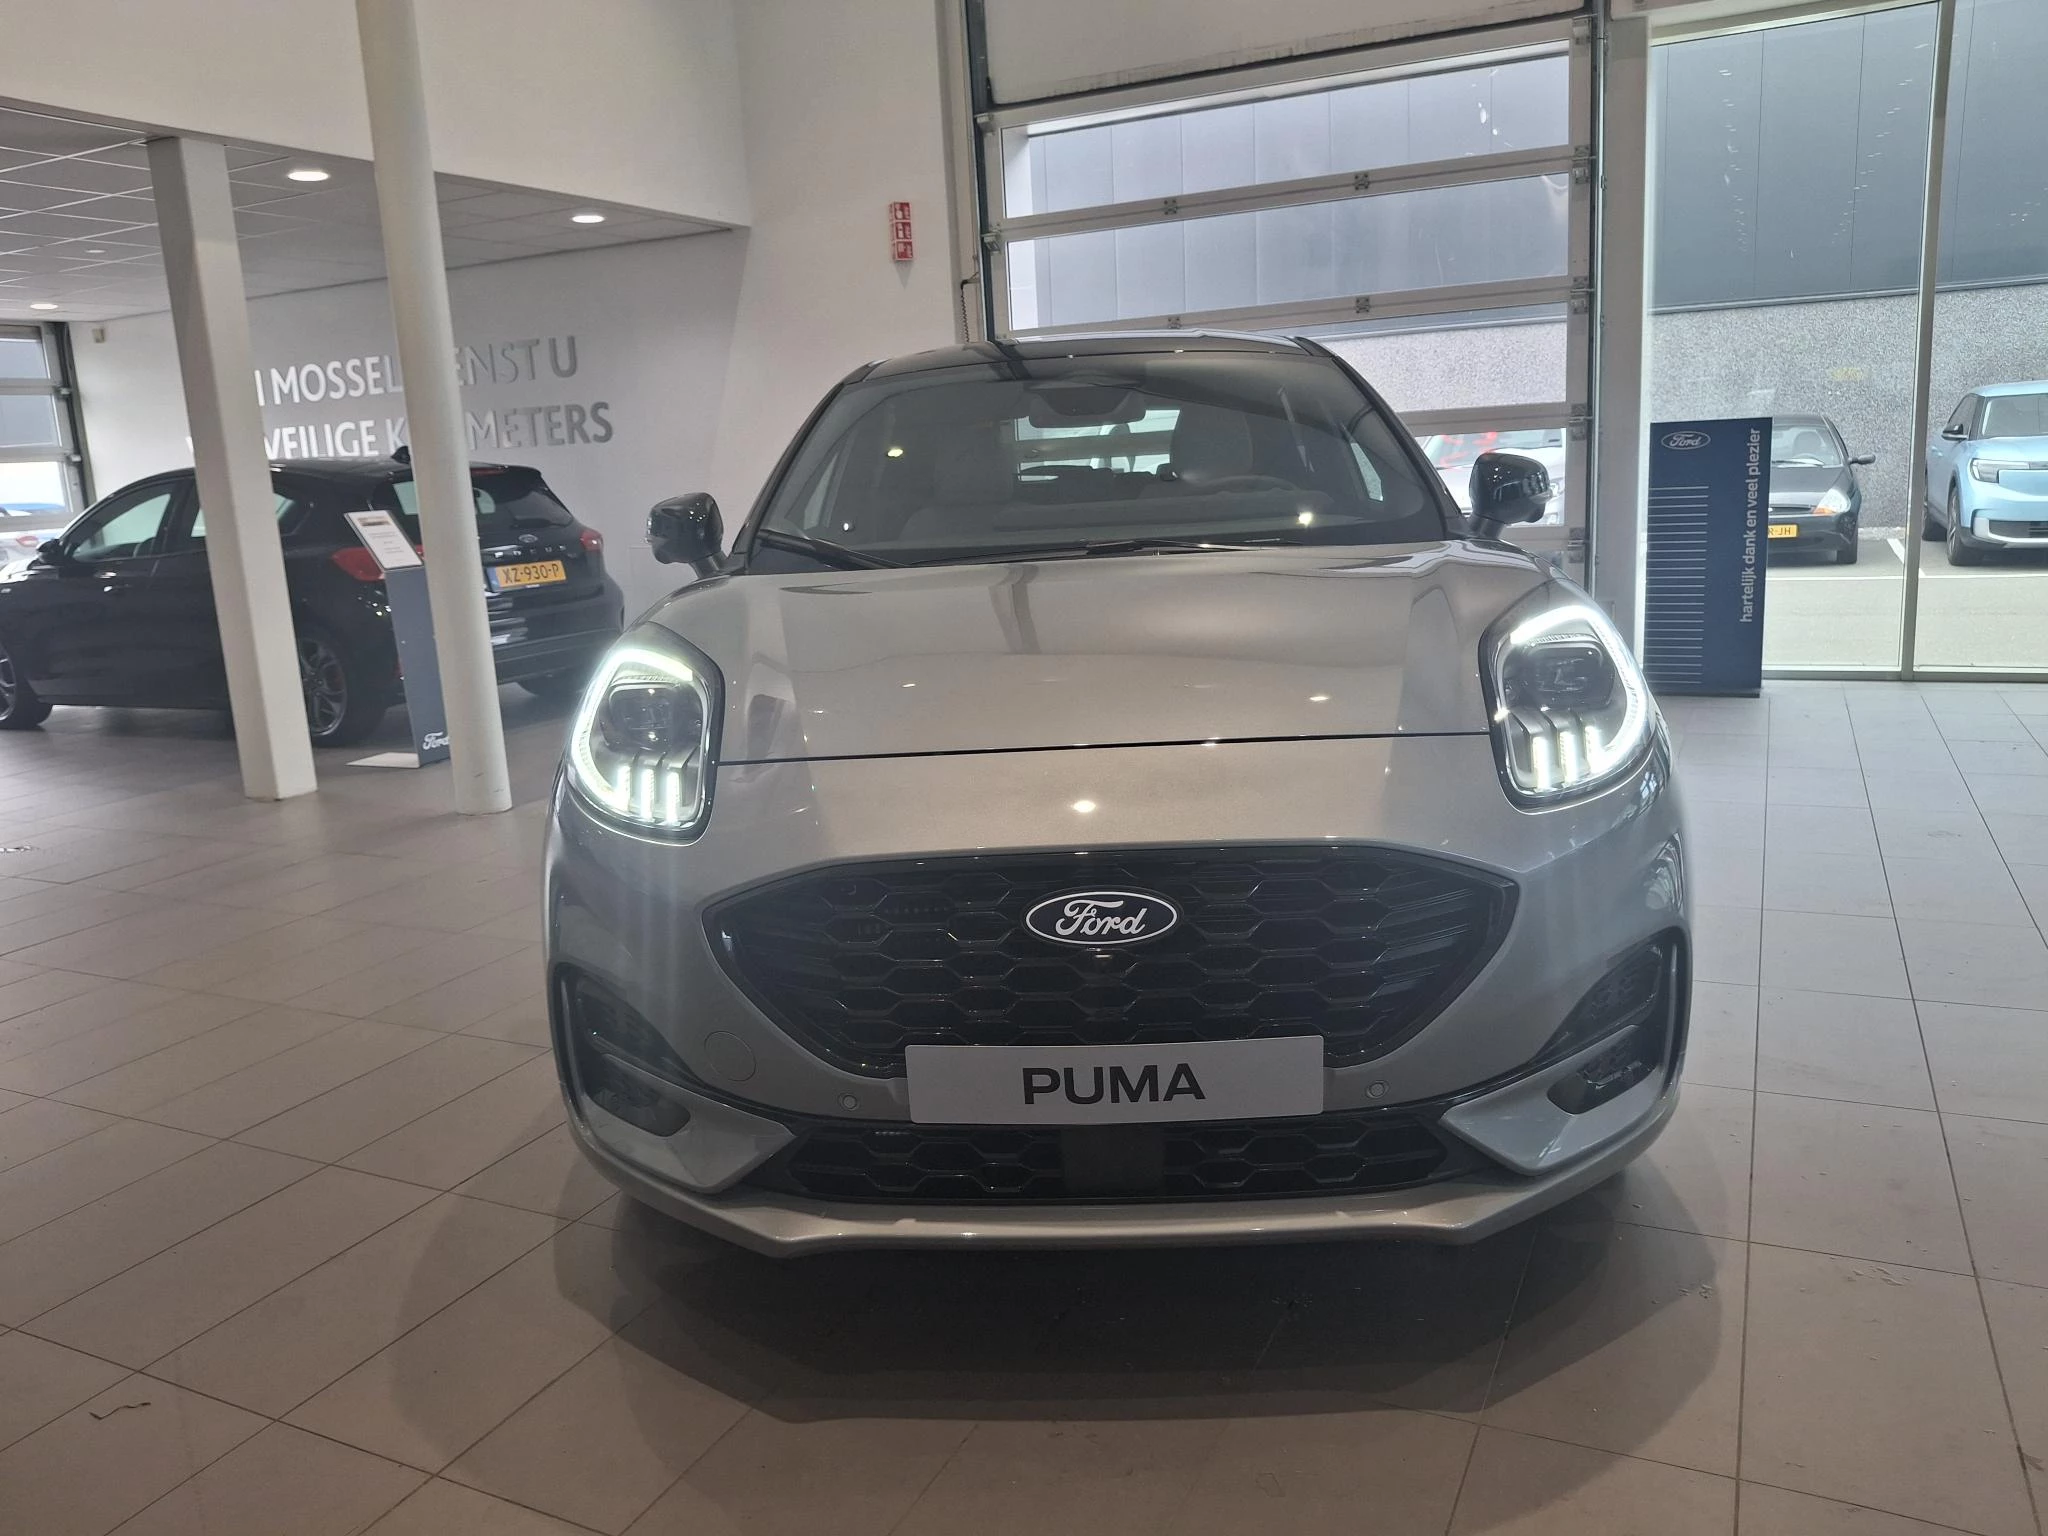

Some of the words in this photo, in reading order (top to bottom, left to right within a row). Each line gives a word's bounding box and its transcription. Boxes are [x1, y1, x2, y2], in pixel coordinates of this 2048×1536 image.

[270, 354, 404, 406] MOSSEL
[548, 335, 578, 379] U
[1668, 432, 1703, 448] Ford
[1745, 428, 1761, 476] plezier
[1745, 478, 1759, 508] veel
[1746, 509, 1758, 527] en
[1742, 529, 1757, 564] dank
[502, 563, 559, 584] XZ-930-P
[1739, 565, 1757, 623] hartelijk
[1054, 898, 1148, 937] Ford
[1022, 1062, 1206, 1105] PUMA
